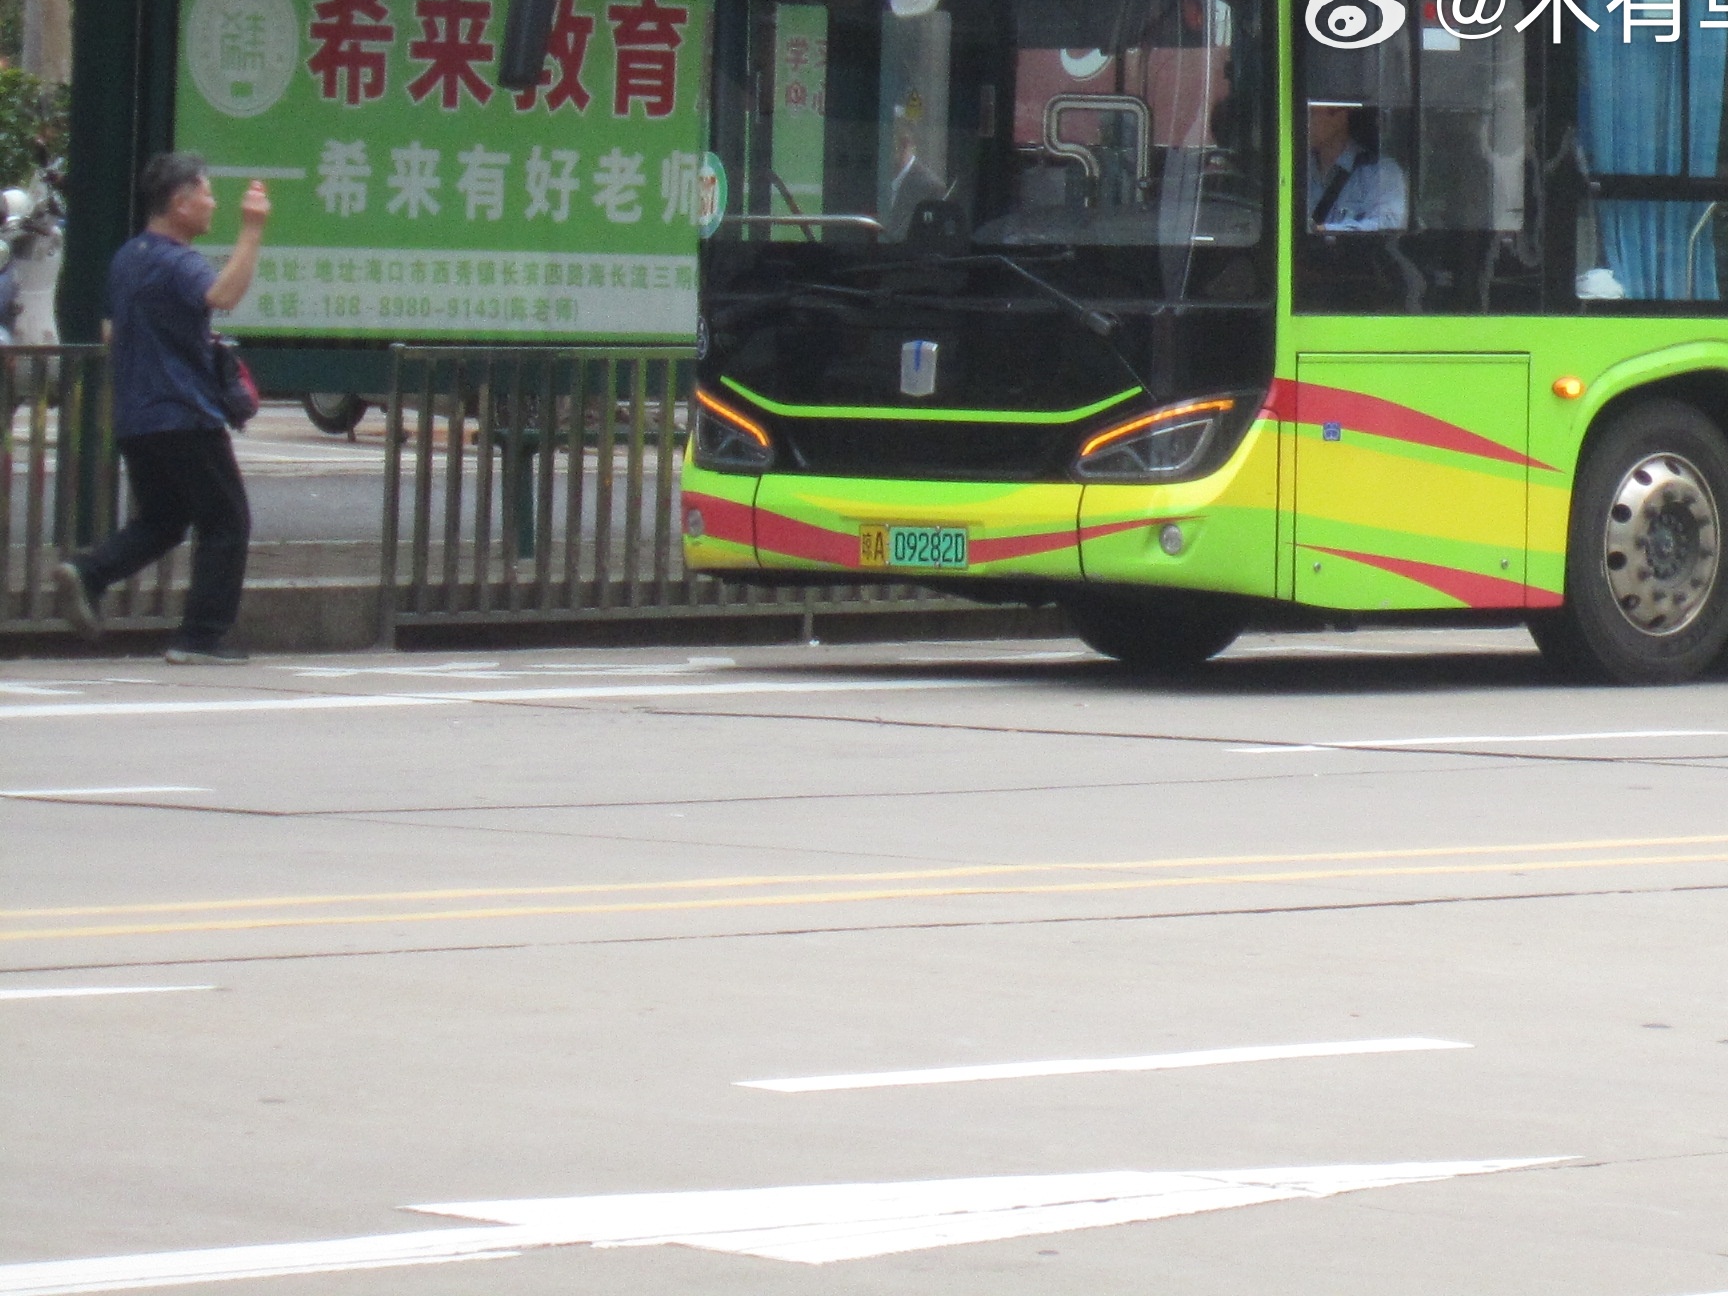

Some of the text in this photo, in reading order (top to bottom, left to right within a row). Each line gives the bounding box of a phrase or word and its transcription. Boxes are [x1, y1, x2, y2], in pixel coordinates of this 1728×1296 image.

[316, 139, 700, 226] 希来有好老师
[895, 532, 965, 562] 09282D
